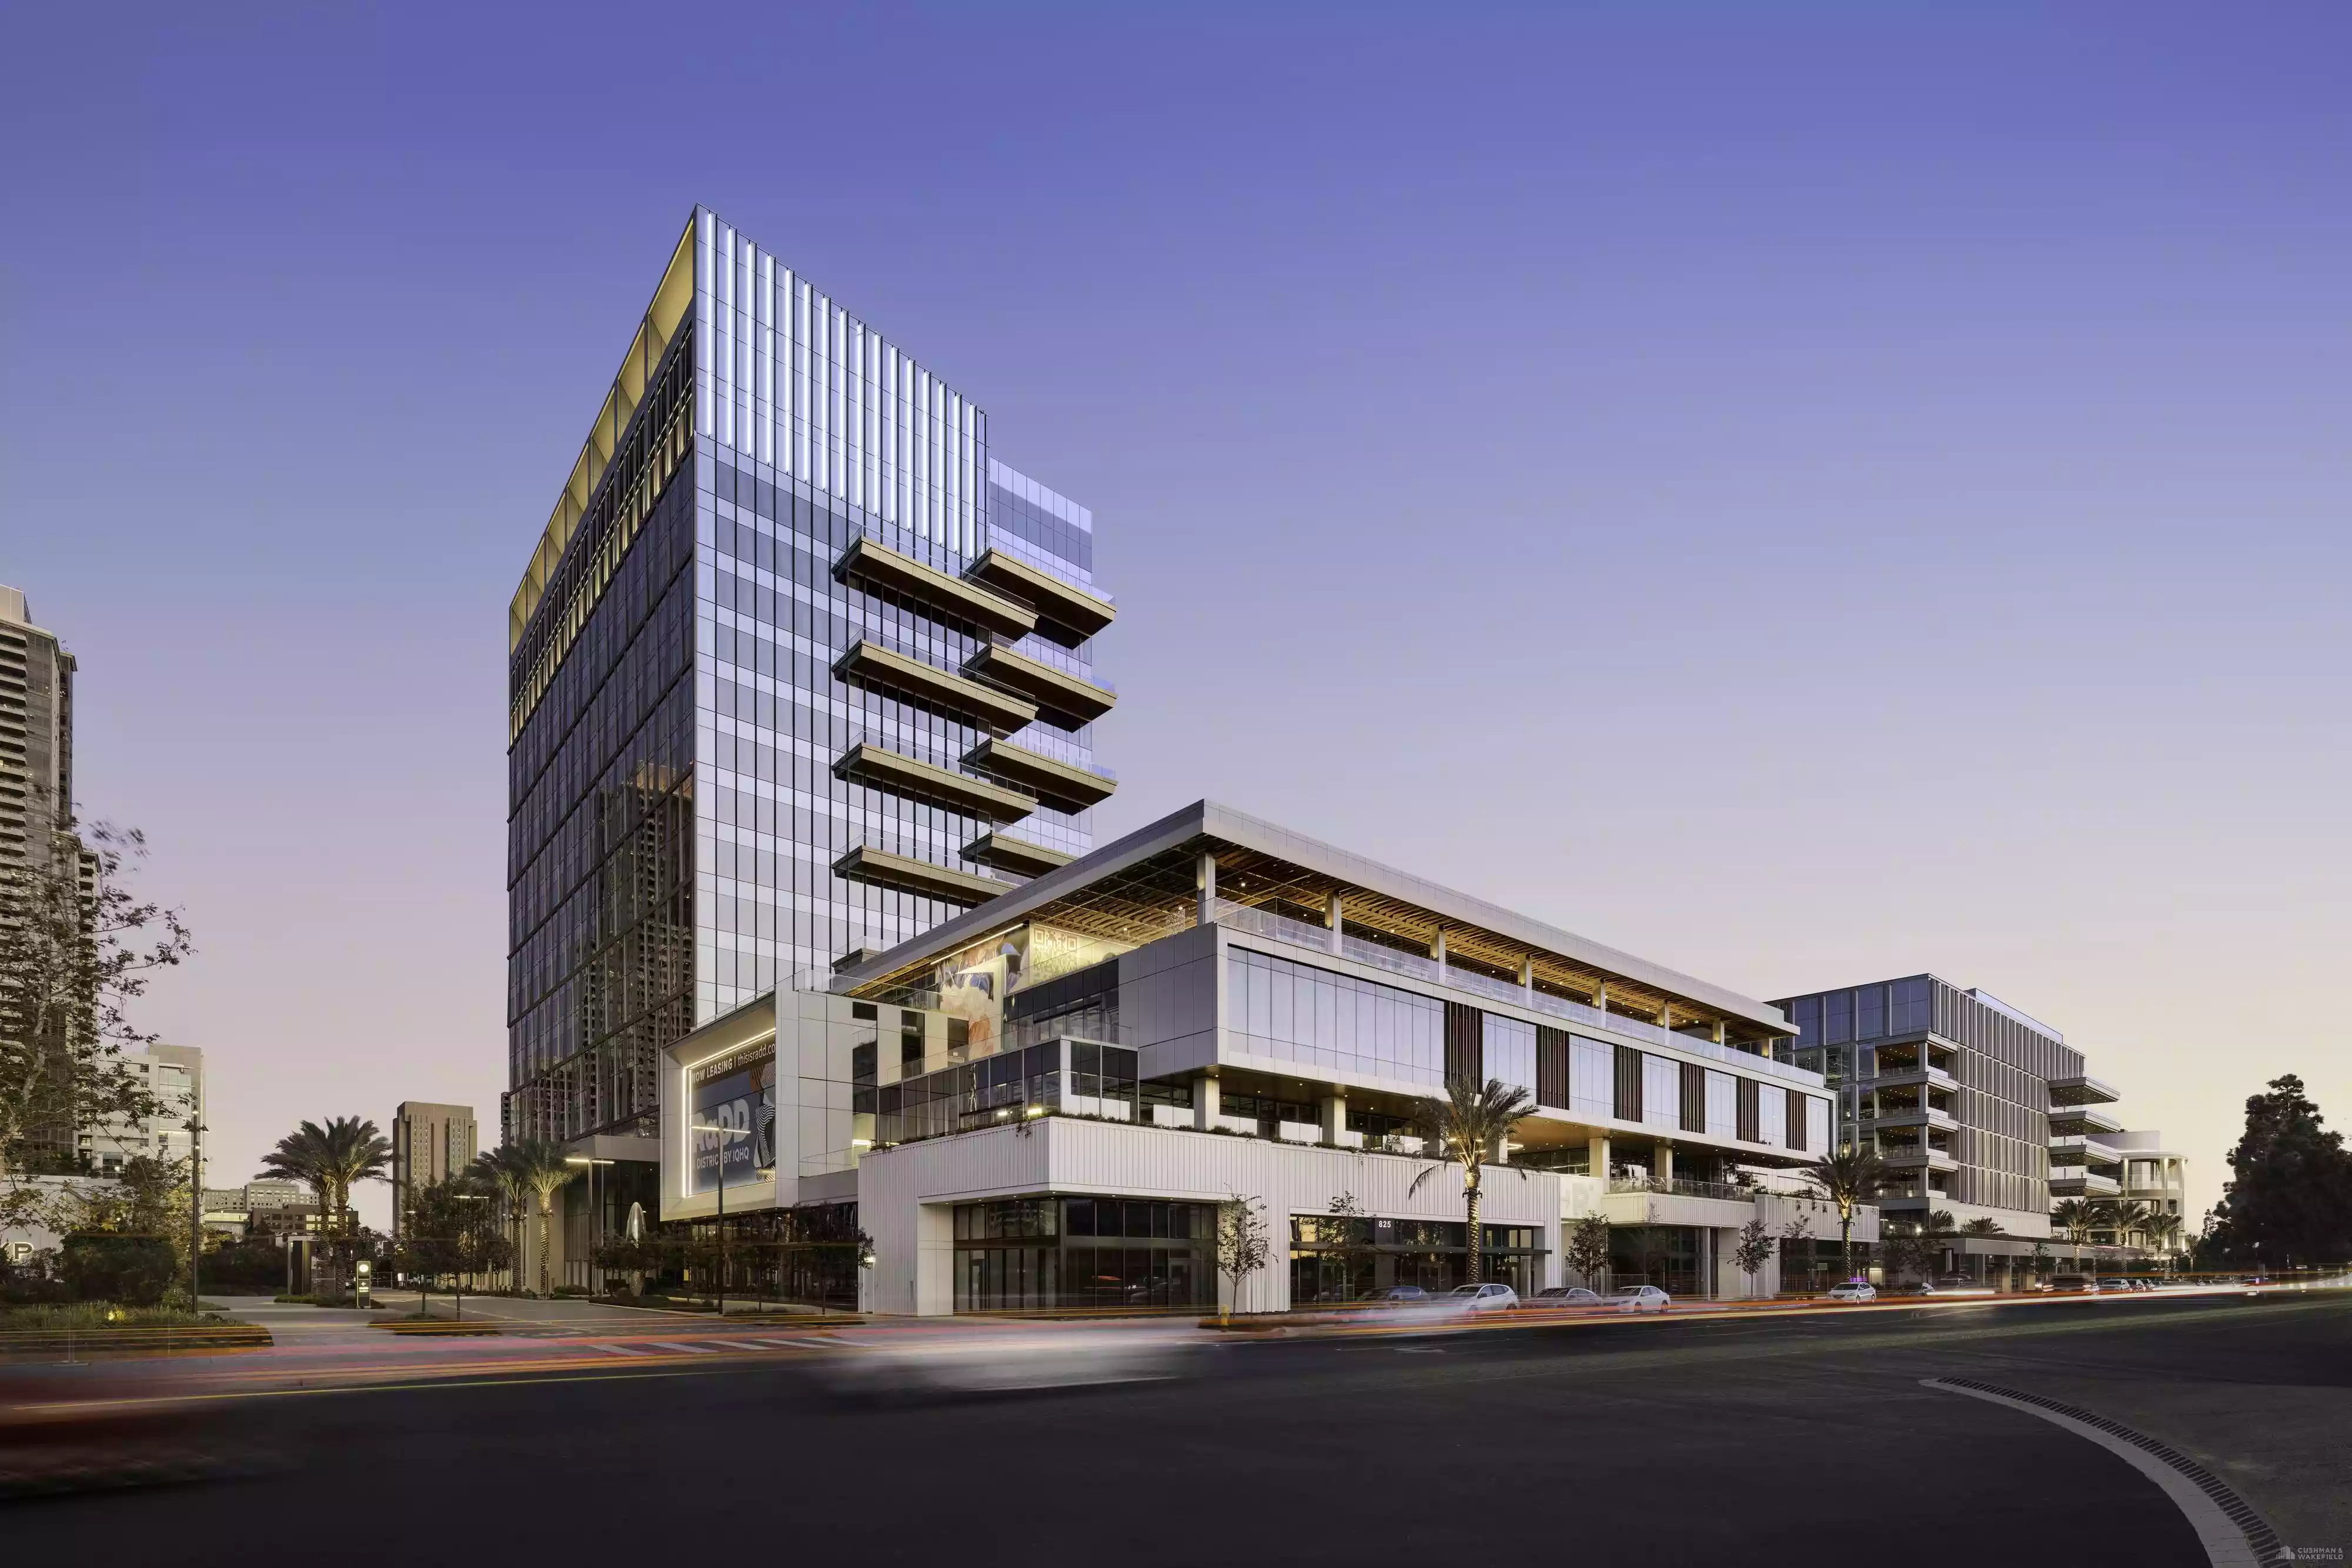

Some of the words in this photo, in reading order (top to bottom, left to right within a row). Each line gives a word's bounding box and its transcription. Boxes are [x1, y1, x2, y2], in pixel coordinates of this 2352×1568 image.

[692, 1068, 705, 1084] NOW
[707, 1058, 733, 1078] LEASING
[738, 1043, 776, 1066] thisisradd.co
[697, 1154, 723, 1169] DISTRIC
[724, 1150, 731, 1164] BY
[733, 1146, 749, 1162] IQHQ
